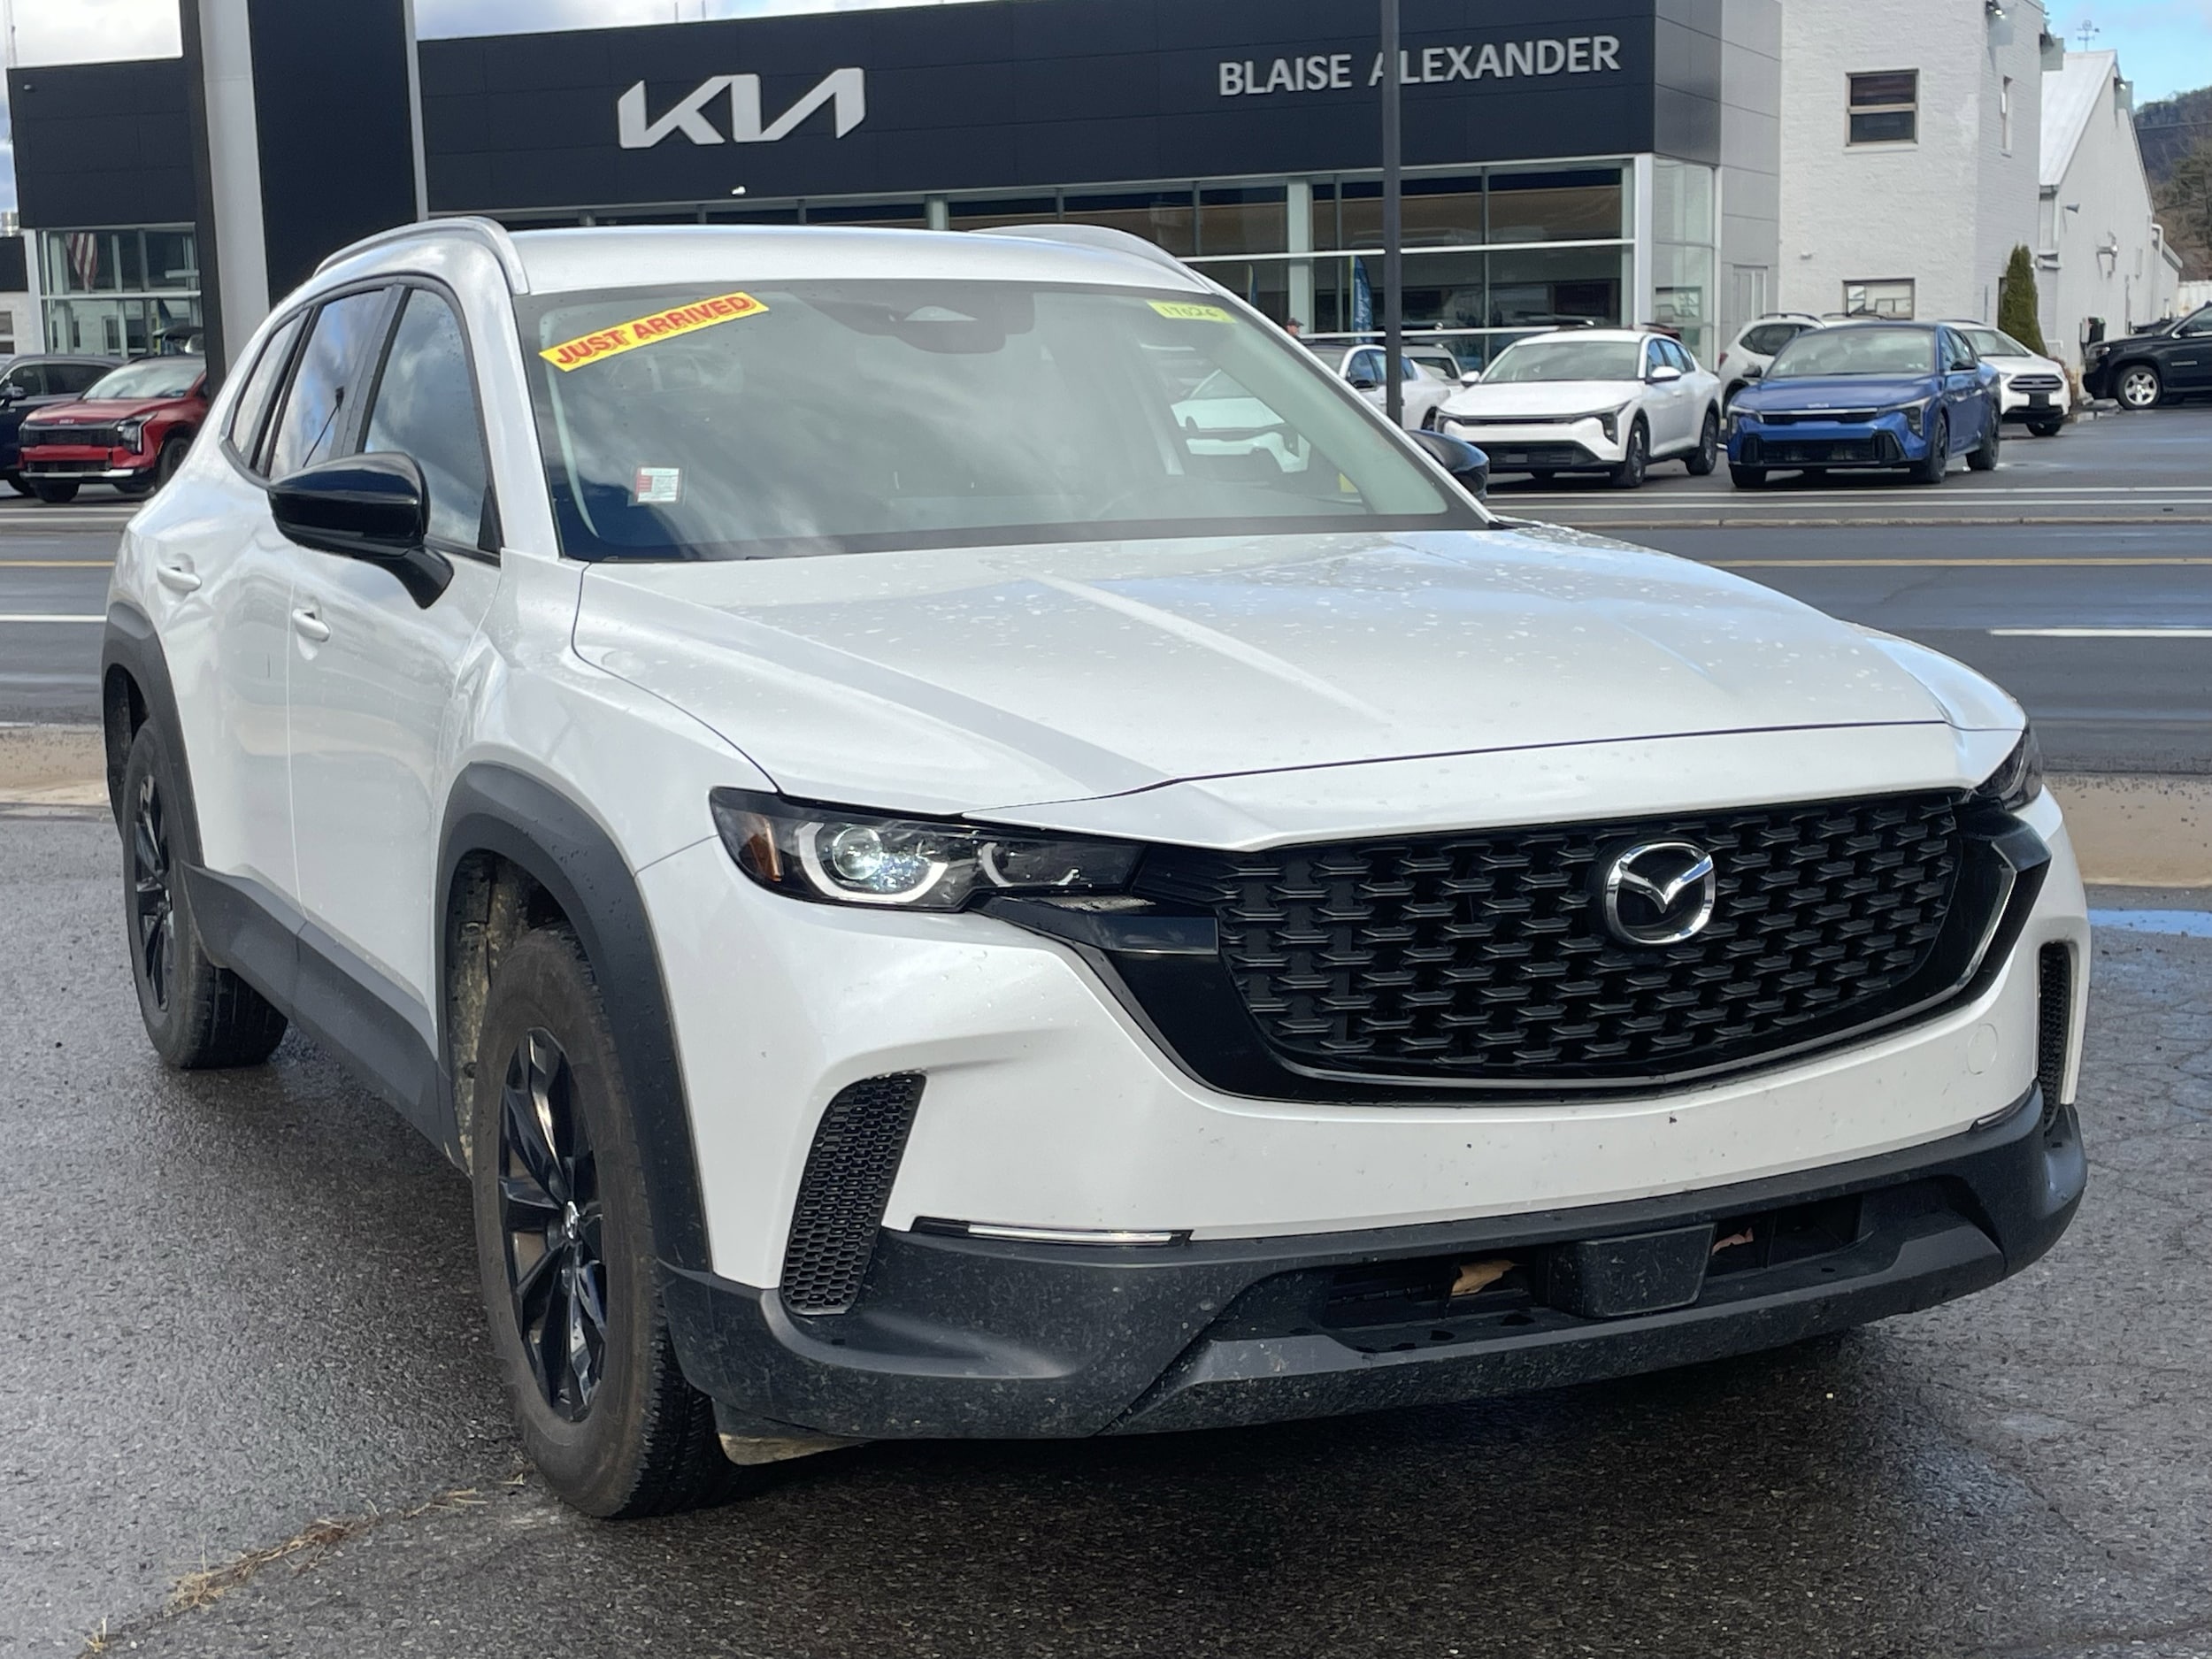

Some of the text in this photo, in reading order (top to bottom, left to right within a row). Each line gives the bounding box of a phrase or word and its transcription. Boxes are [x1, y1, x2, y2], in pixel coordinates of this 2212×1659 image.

[618, 67, 865, 149] KIA
[1219, 54, 1352, 96] BLAISE
[557, 296, 757, 366] JUST ARRIVED
